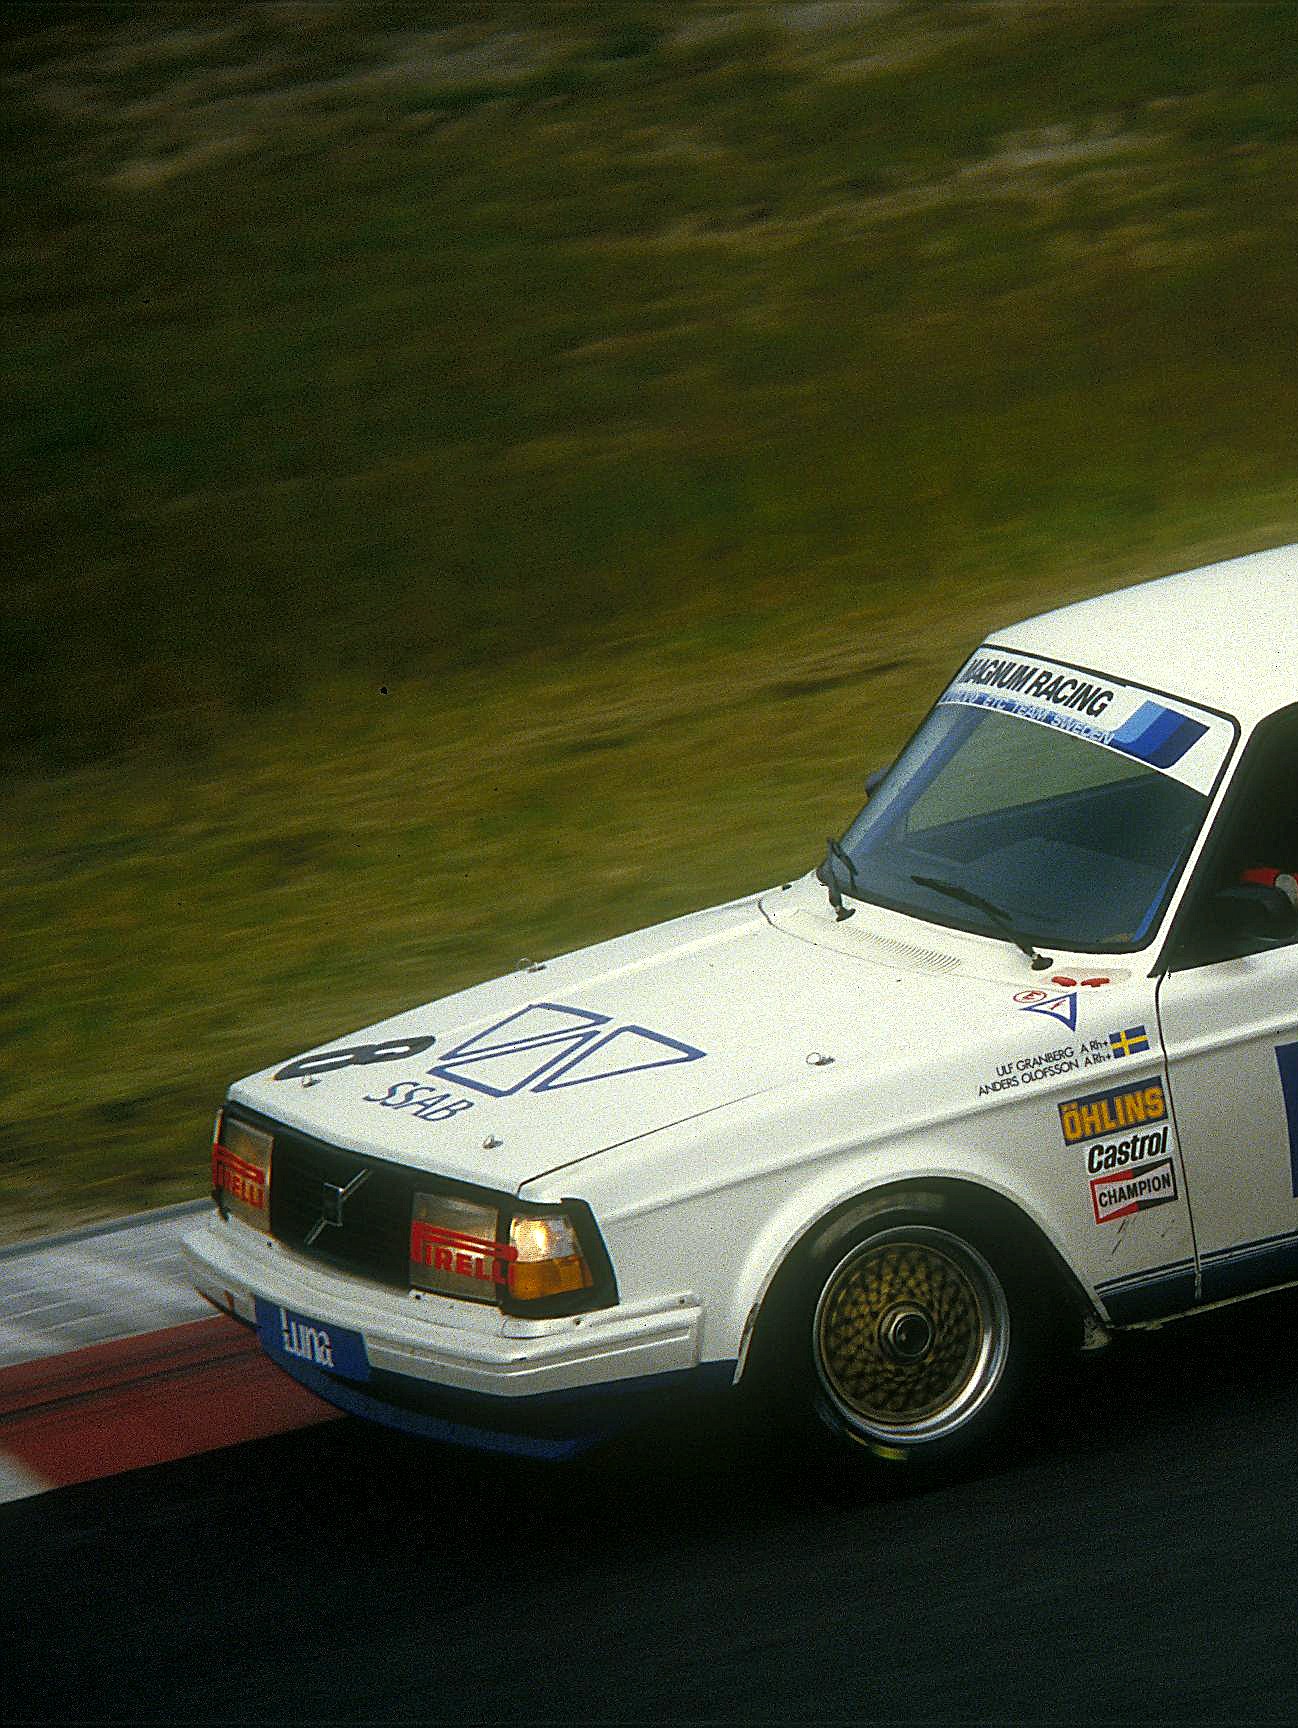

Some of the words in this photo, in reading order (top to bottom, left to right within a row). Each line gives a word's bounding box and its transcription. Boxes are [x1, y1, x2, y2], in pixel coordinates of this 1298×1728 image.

[1024, 667, 1114, 718] RACING
[1011, 701, 1048, 721] TEAM
[1048, 713, 1116, 745] SWEDEN
[273, 1035, 436, 1081] 8
[979, 1075, 1019, 1096] ANDERS
[1021, 1058, 1079, 1084] OLOFSSON
[1084, 1056, 1093, 1067] A
[996, 1062, 1014, 1077] ULF
[1016, 1046, 1074, 1072] GRANBERG
[1080, 1042, 1089, 1053] A
[362, 1082, 474, 1121] SSAB
[1062, 1087, 1165, 1142] ÖHLINS
[1087, 1127, 1169, 1174] Castrol
[1098, 1172, 1171, 1209] CHAMPION
